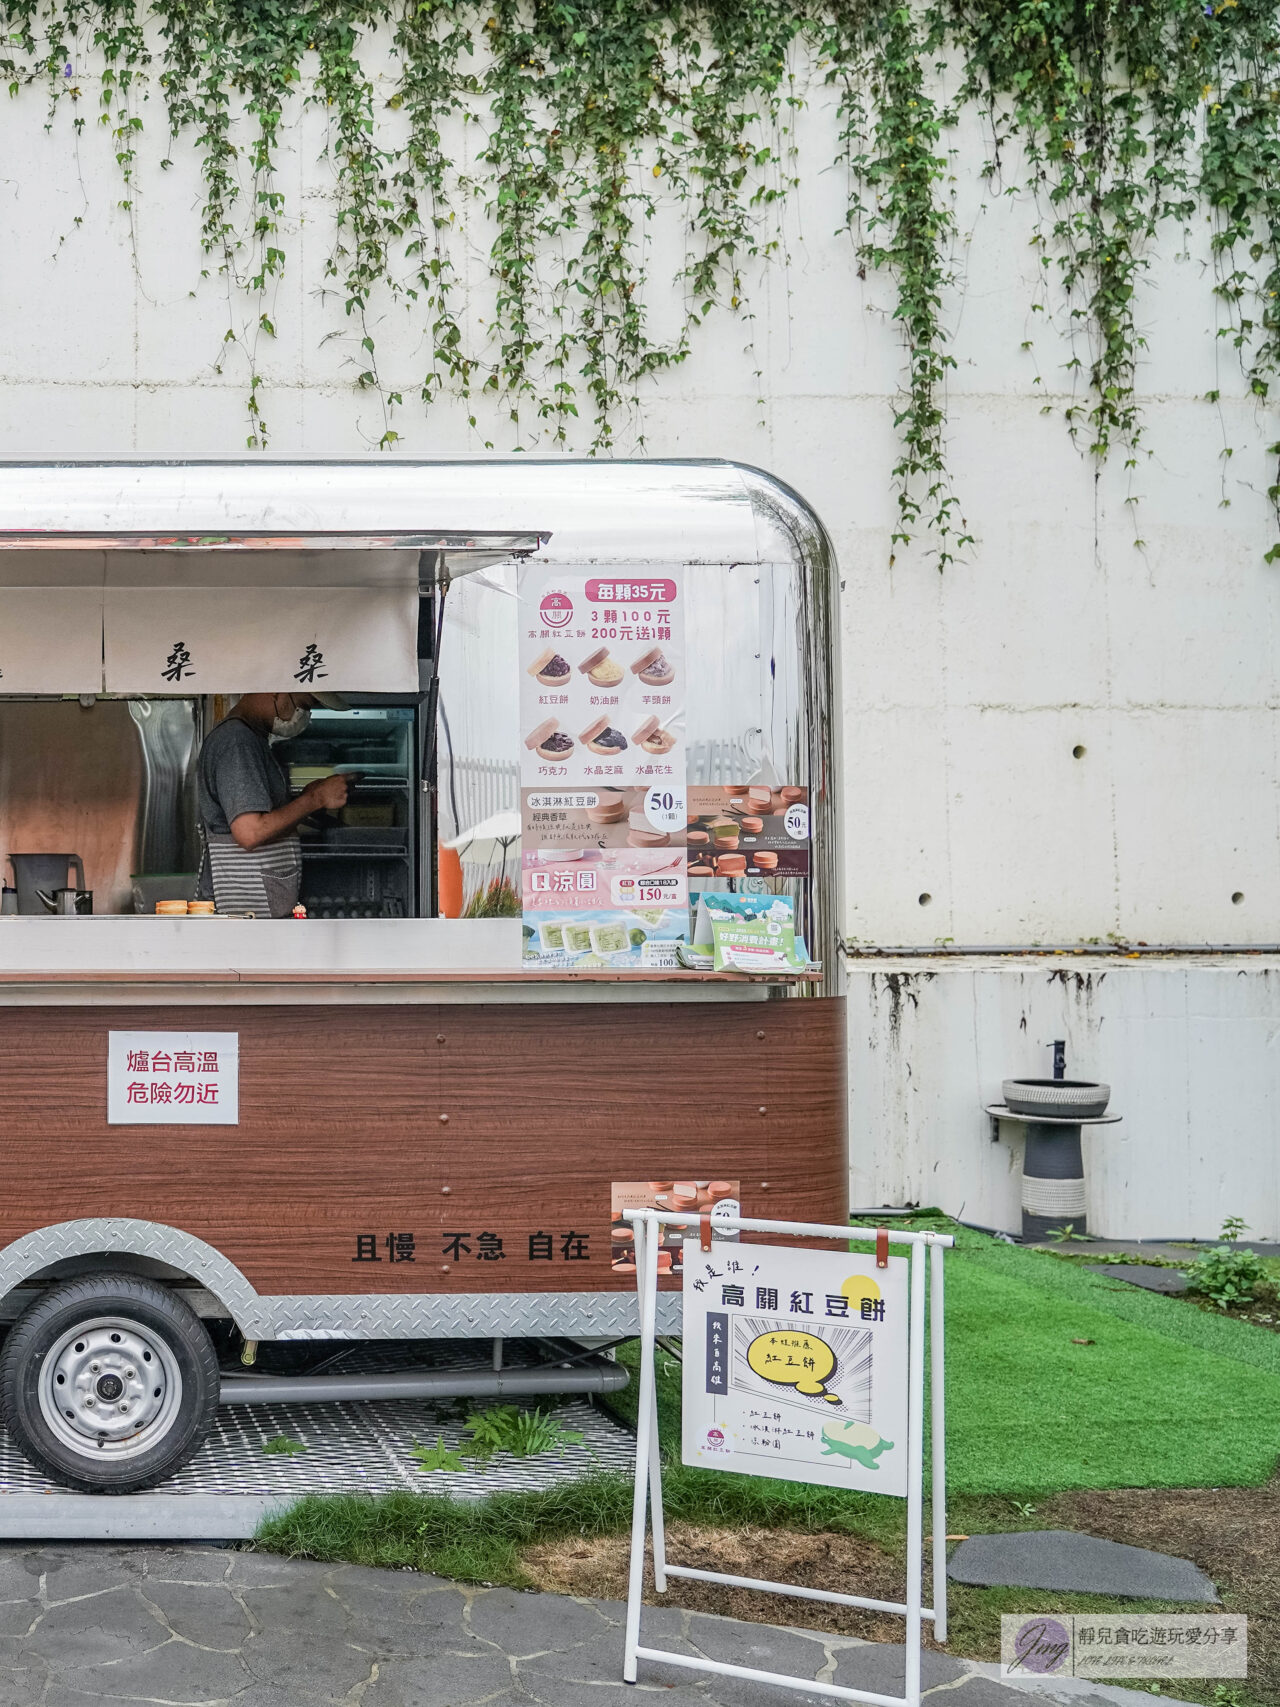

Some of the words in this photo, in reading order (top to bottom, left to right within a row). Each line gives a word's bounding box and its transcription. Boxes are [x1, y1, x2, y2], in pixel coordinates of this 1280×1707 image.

[597, 583, 666, 600] 每顆35元
[591, 626, 671, 640] 200元送1顆
[161, 641, 196, 682] 桑
[293, 643, 329, 683] 桑
[538, 695, 569, 704] 紅豆餅
[590, 696, 619, 705] 奶油餅
[642, 695, 671, 704] 芋頭餅
[538, 766, 568, 776] 巧克力
[584, 765, 623, 775] 水晶芝麻
[635, 765, 673, 775] 水晶花生
[531, 797, 597, 807] 冰淇淋紅豆餅
[650, 792, 684, 811] 50元
[532, 812, 568, 822] 經典香草
[531, 871, 597, 892] Q涼圓
[127, 1050, 219, 1072] 爐台高溫
[127, 1082, 219, 1104] 危險勿近
[351, 1232, 416, 1264] 且慢
[441, 1231, 507, 1262] 不急
[527, 1230, 591, 1261] 自在
[721, 1284, 886, 1322] 高關紅豆餅
[765, 1353, 816, 1372] 紅豆餅
